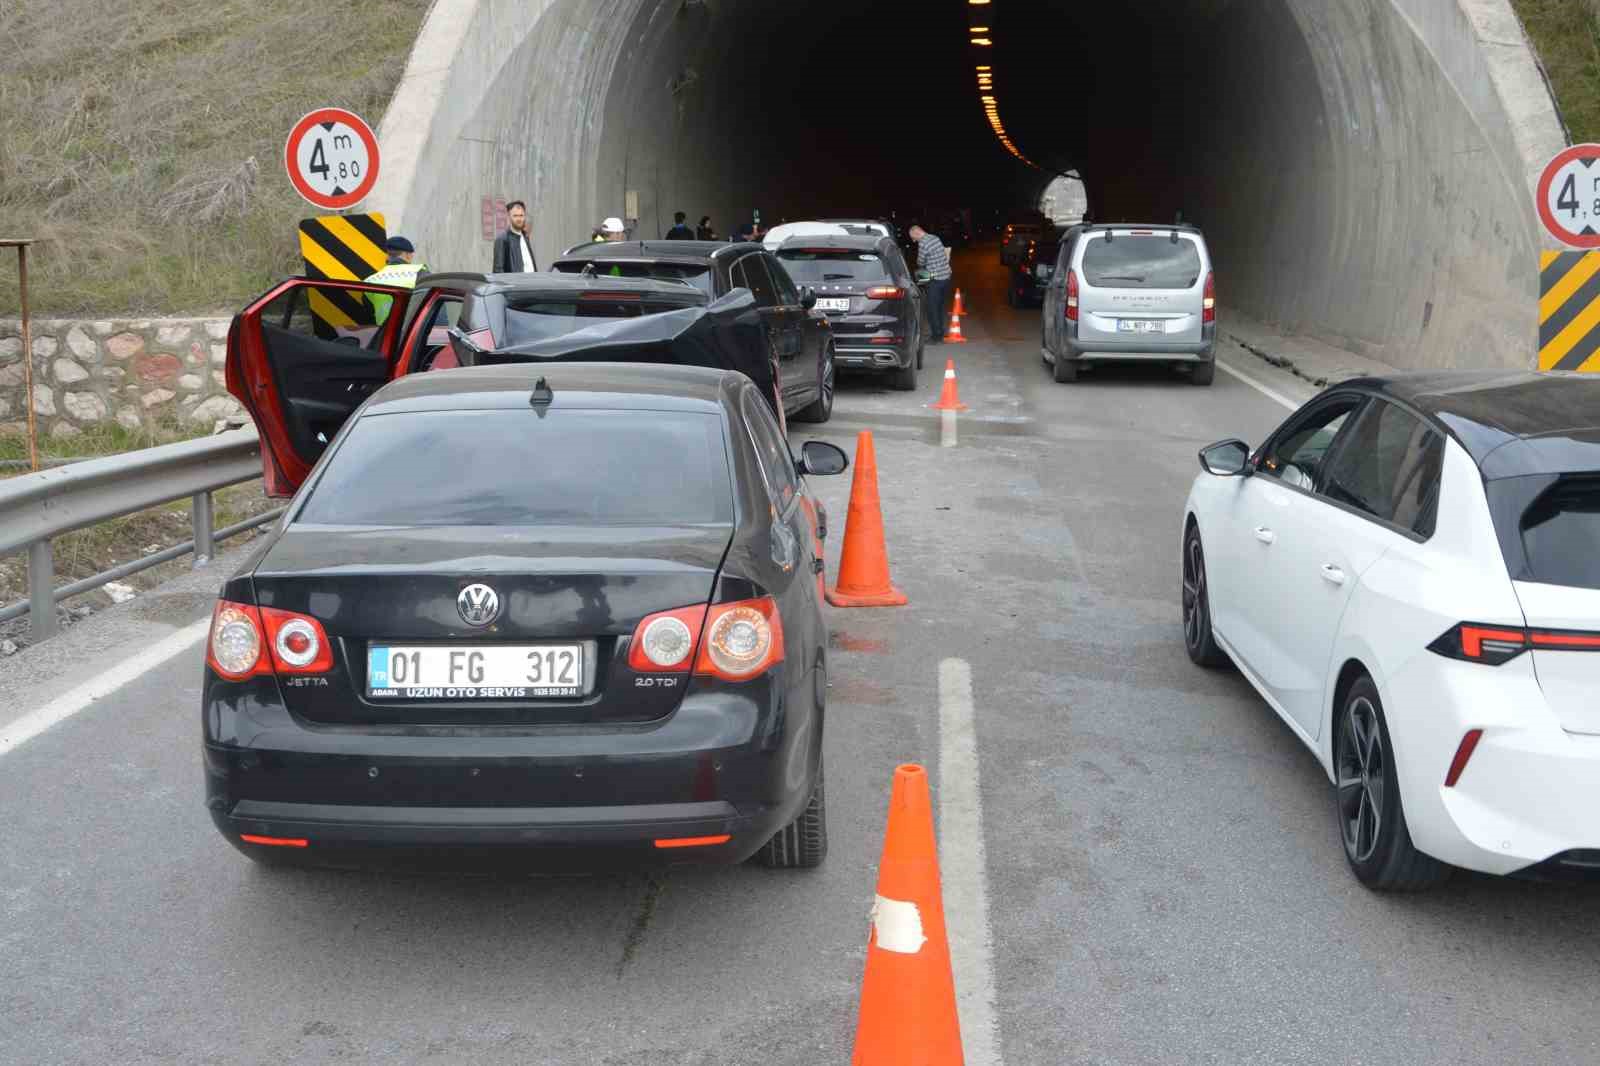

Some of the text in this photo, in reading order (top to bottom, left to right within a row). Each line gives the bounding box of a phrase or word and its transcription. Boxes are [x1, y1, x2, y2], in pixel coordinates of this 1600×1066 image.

[334, 134, 352, 149] m
[392, 650, 575, 684] 01 FG 312
[287, 677, 328, 687] JETTA
[372, 688, 399, 696] ADANA
[406, 687, 443, 698] UZUN
[446, 687, 477, 698] OTO
